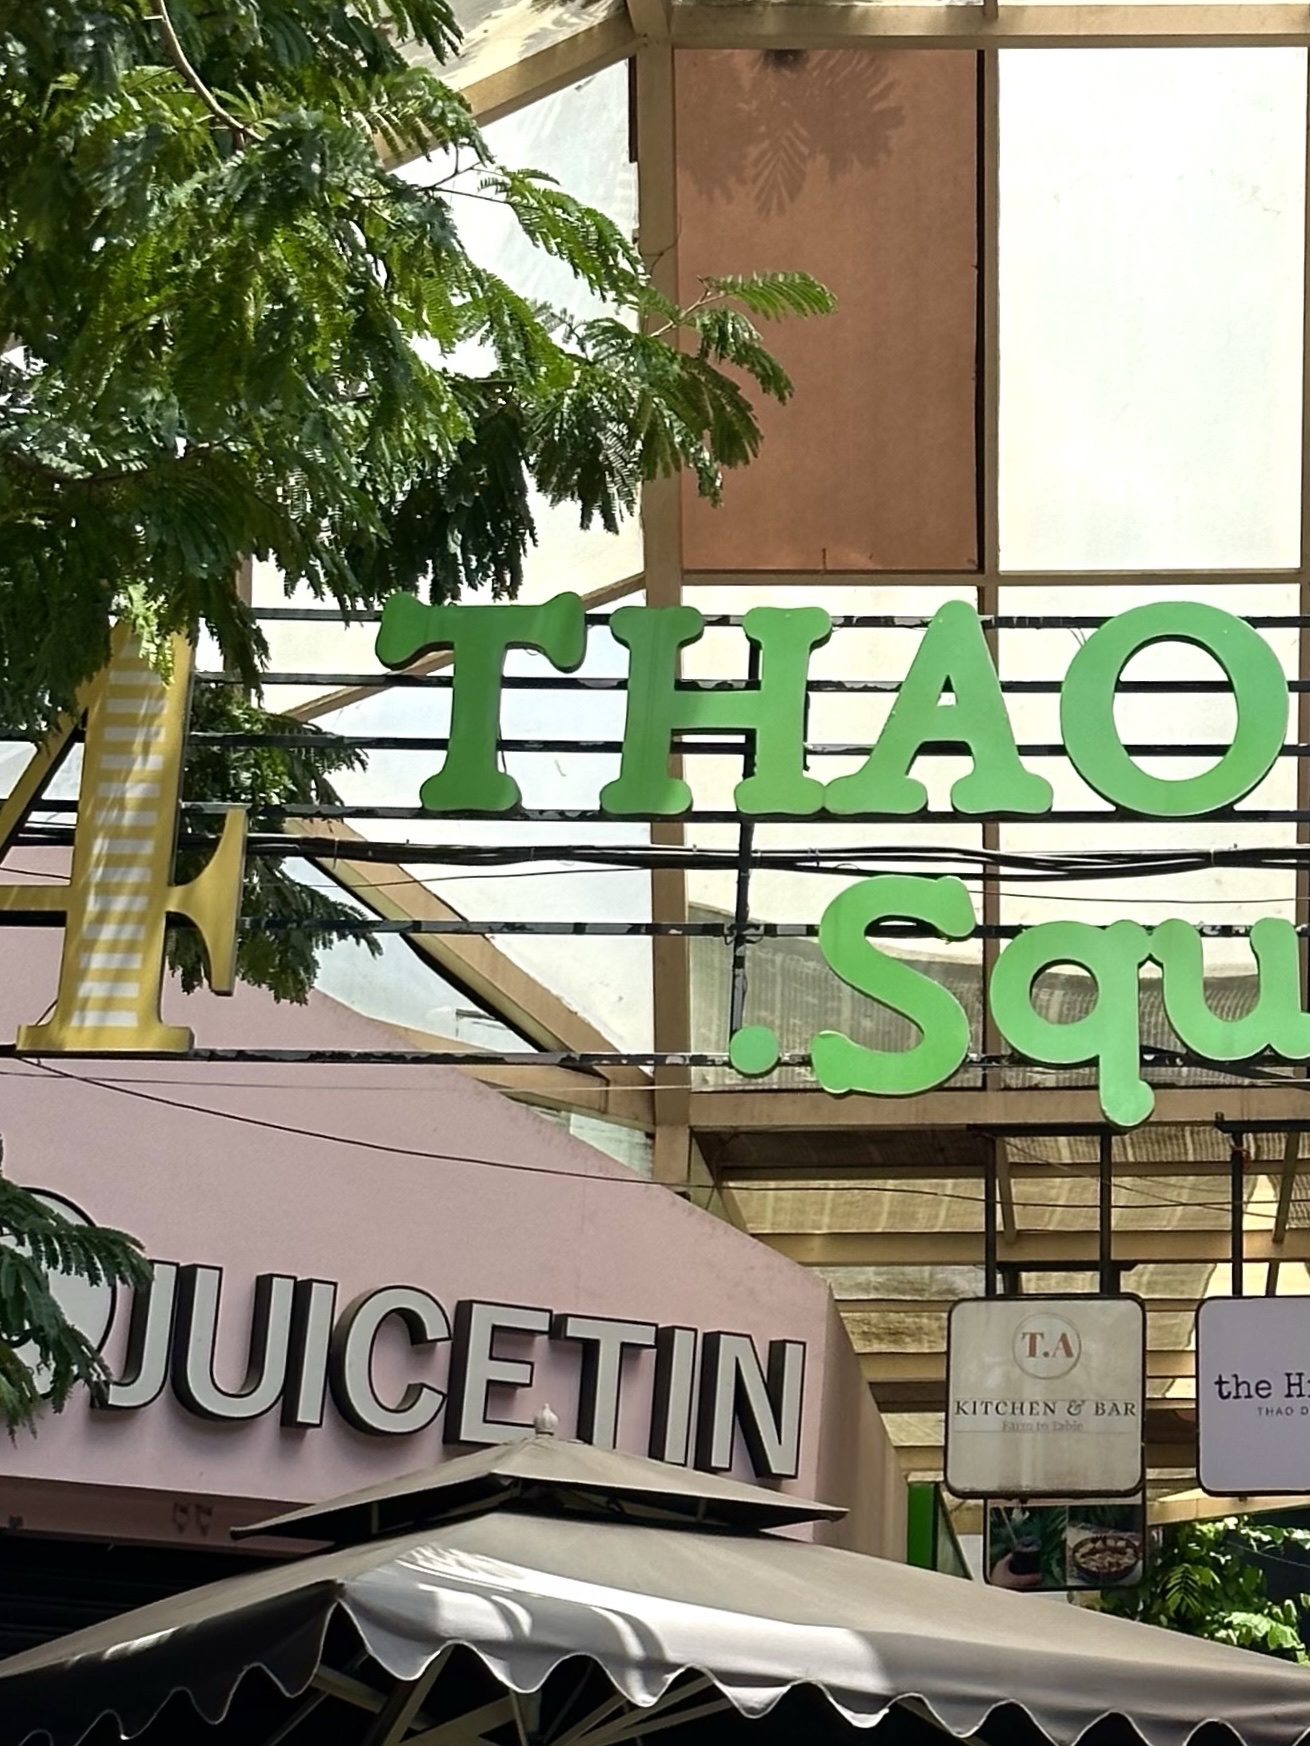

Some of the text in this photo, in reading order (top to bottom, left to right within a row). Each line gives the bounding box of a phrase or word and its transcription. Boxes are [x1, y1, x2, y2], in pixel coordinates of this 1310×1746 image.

[376, 590, 1290, 818] THAO
[1021, 1331, 1075, 1359] T.A
[91, 1258, 807, 1480] JUICETIN
[1214, 1373, 1272, 1401] the
[954, 1399, 1138, 1418] KITCHEN & BAR
[1257, 1405, 1295, 1417] THAO
